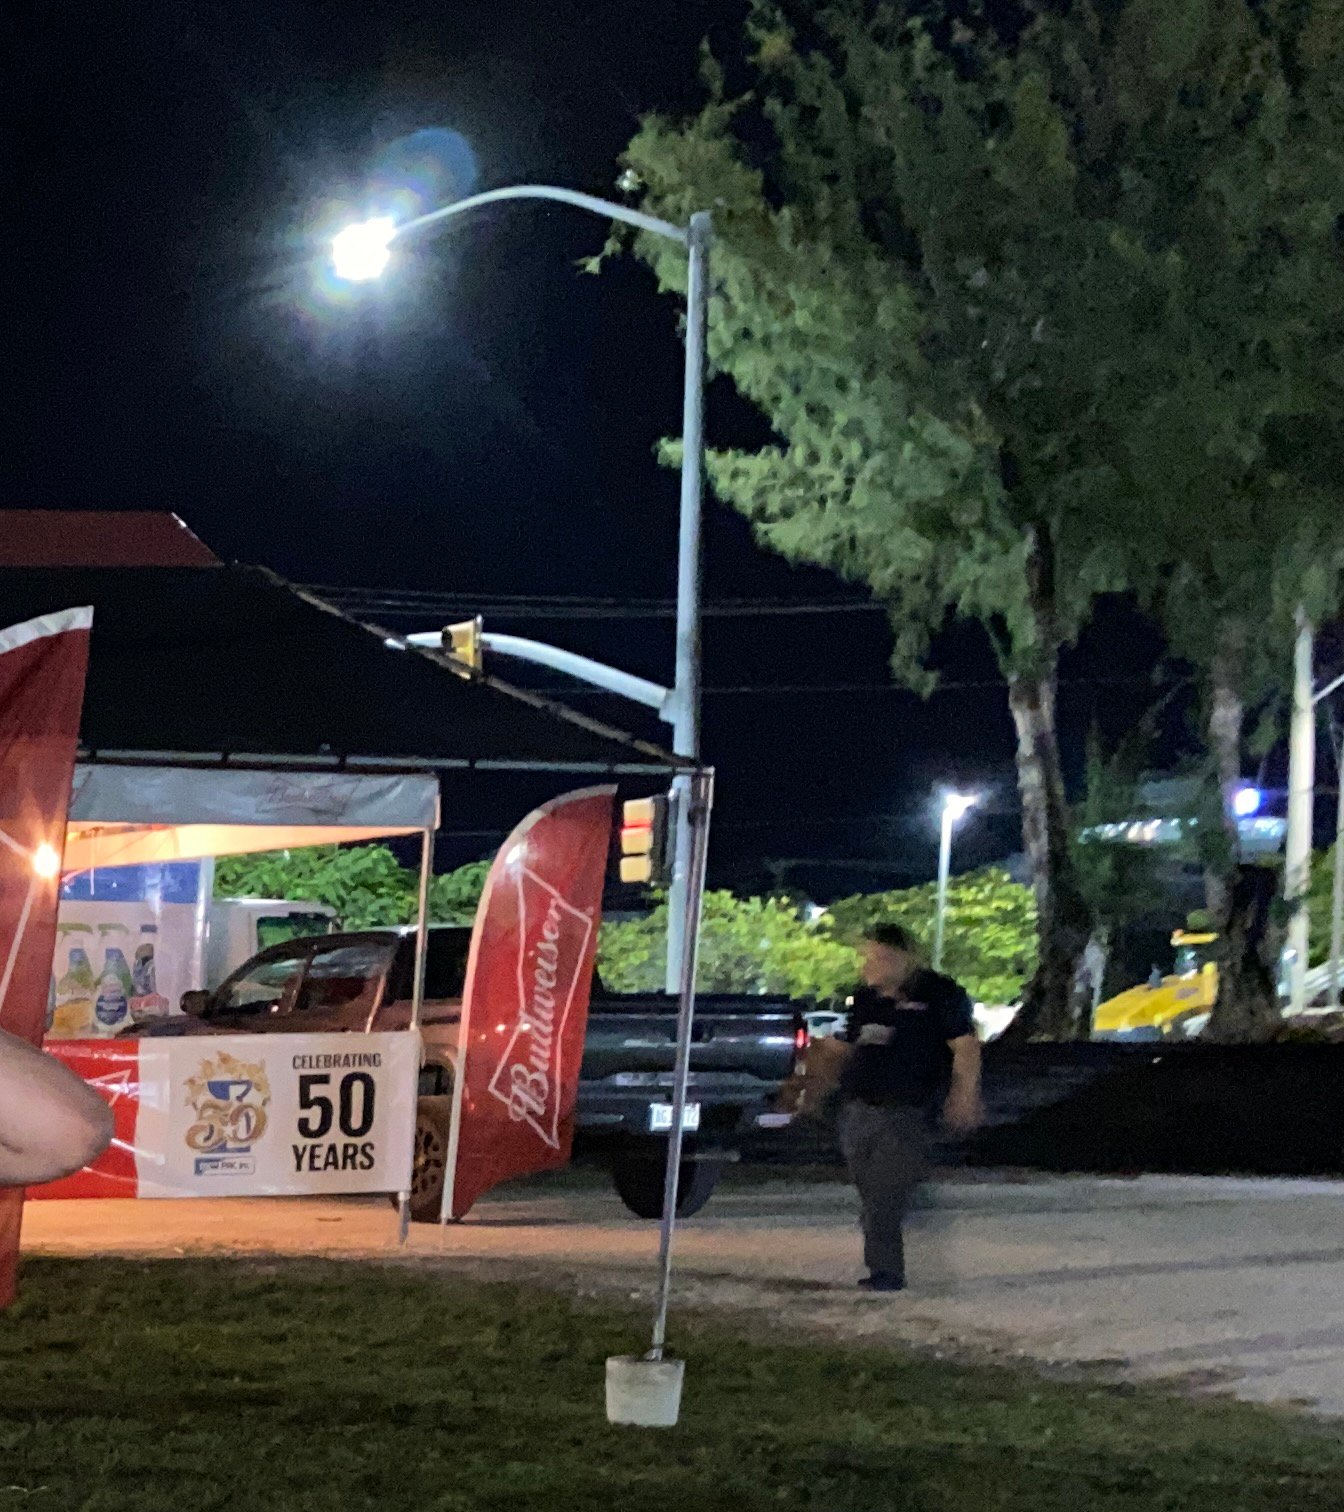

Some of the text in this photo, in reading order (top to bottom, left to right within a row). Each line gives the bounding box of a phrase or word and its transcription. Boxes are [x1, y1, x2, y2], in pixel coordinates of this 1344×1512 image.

[508, 899, 562, 1121] Budweiser
[292, 1053, 381, 1070] CELEBRATING
[297, 1071, 376, 1139] 50
[292, 1142, 375, 1173] YEARS
